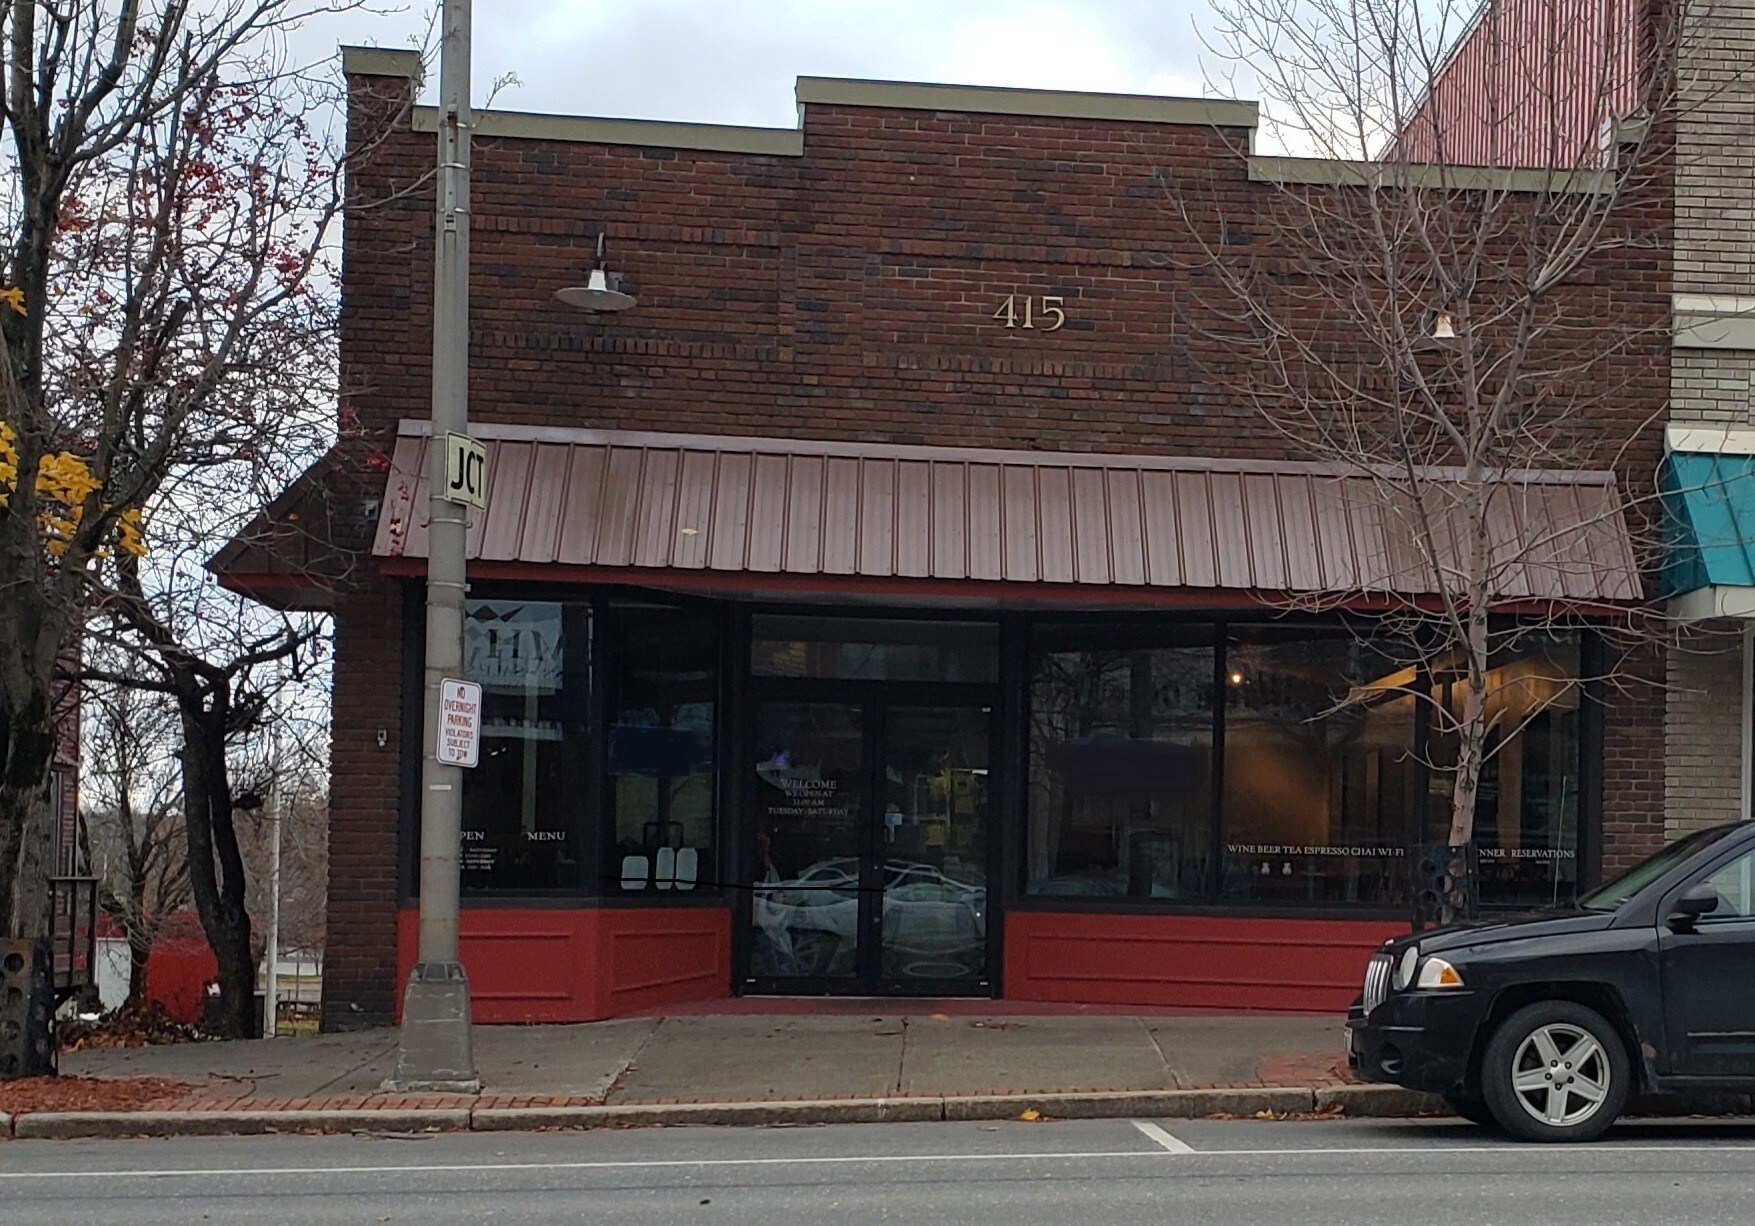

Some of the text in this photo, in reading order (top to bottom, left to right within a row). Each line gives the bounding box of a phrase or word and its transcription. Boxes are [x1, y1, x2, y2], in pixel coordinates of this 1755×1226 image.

[993, 295, 1065, 332] 415
[451, 447, 483, 499] JCT
[457, 687, 465, 699] NO
[444, 699, 477, 714] OVERNIGHT
[447, 714, 472, 728] PARKING
[445, 728, 473, 739] VIOLATORS
[447, 739, 470, 749] SUBJECT
[448, 748, 468, 759] TO TOW
[781, 780, 837, 790] WELCOME
[799, 790, 821, 798] OPEN
[812, 799, 825, 807] AM
[460, 831, 484, 841] PEN
[527, 831, 566, 841] MENU
[1228, 844, 1255, 853] WINE
[1257, 845, 1281, 854] BEER
[1282, 845, 1302, 854] TEA
[1304, 846, 1349, 856] ESPRESSO
[1351, 848, 1376, 857] CHAI
[1479, 849, 1575, 858] NNER RESERVATIONS
